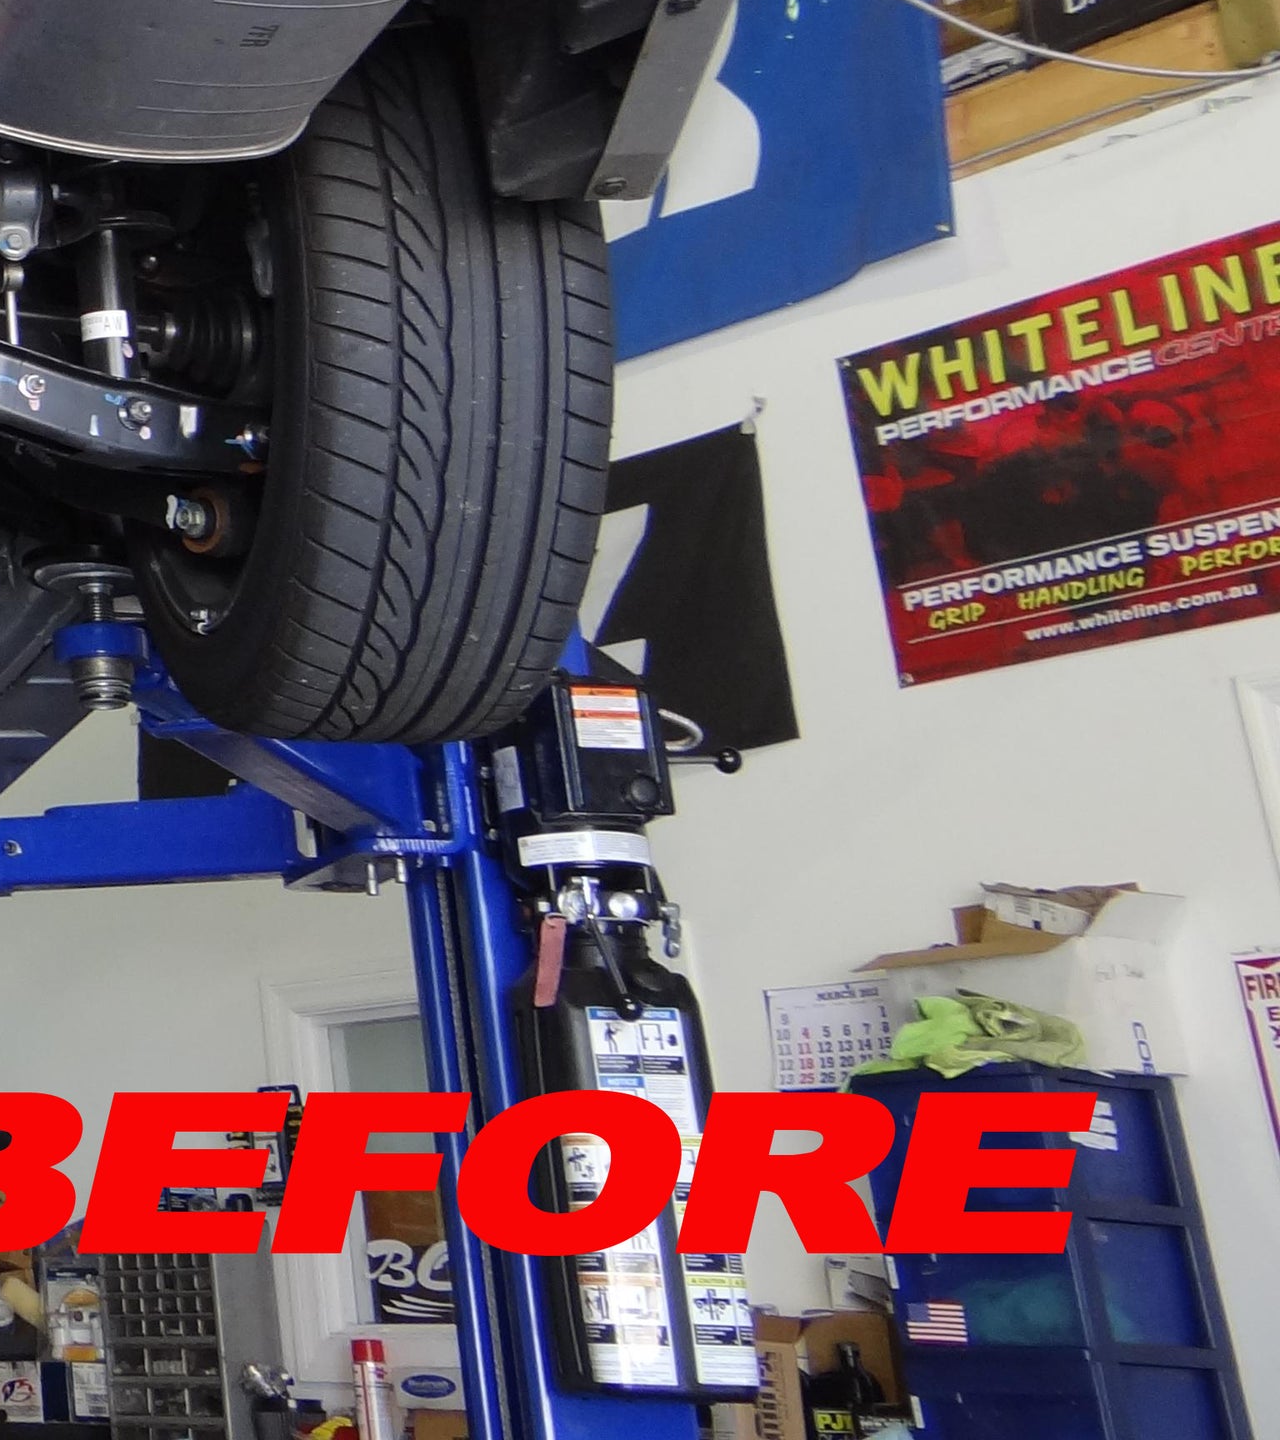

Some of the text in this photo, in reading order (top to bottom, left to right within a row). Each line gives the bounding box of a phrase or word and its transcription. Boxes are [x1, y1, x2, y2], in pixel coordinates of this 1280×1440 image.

[875, 349, 1155, 447] PERFORMANCE
[902, 539, 1143, 611] PERFORMANCE
[927, 601, 987, 632] GRIP
[1017, 566, 1146, 611] HANDLING
[1022, 581, 1259, 642] www.whiteline.com.au
[1243, 972, 1280, 1002] FIR
[797, 1042, 813, 1055] 11
[817, 1041, 834, 1054] 12
[857, 1038, 873, 1052] 14
[822, 1026, 832, 1038] 5
[861, 1022, 872, 1035] 7
